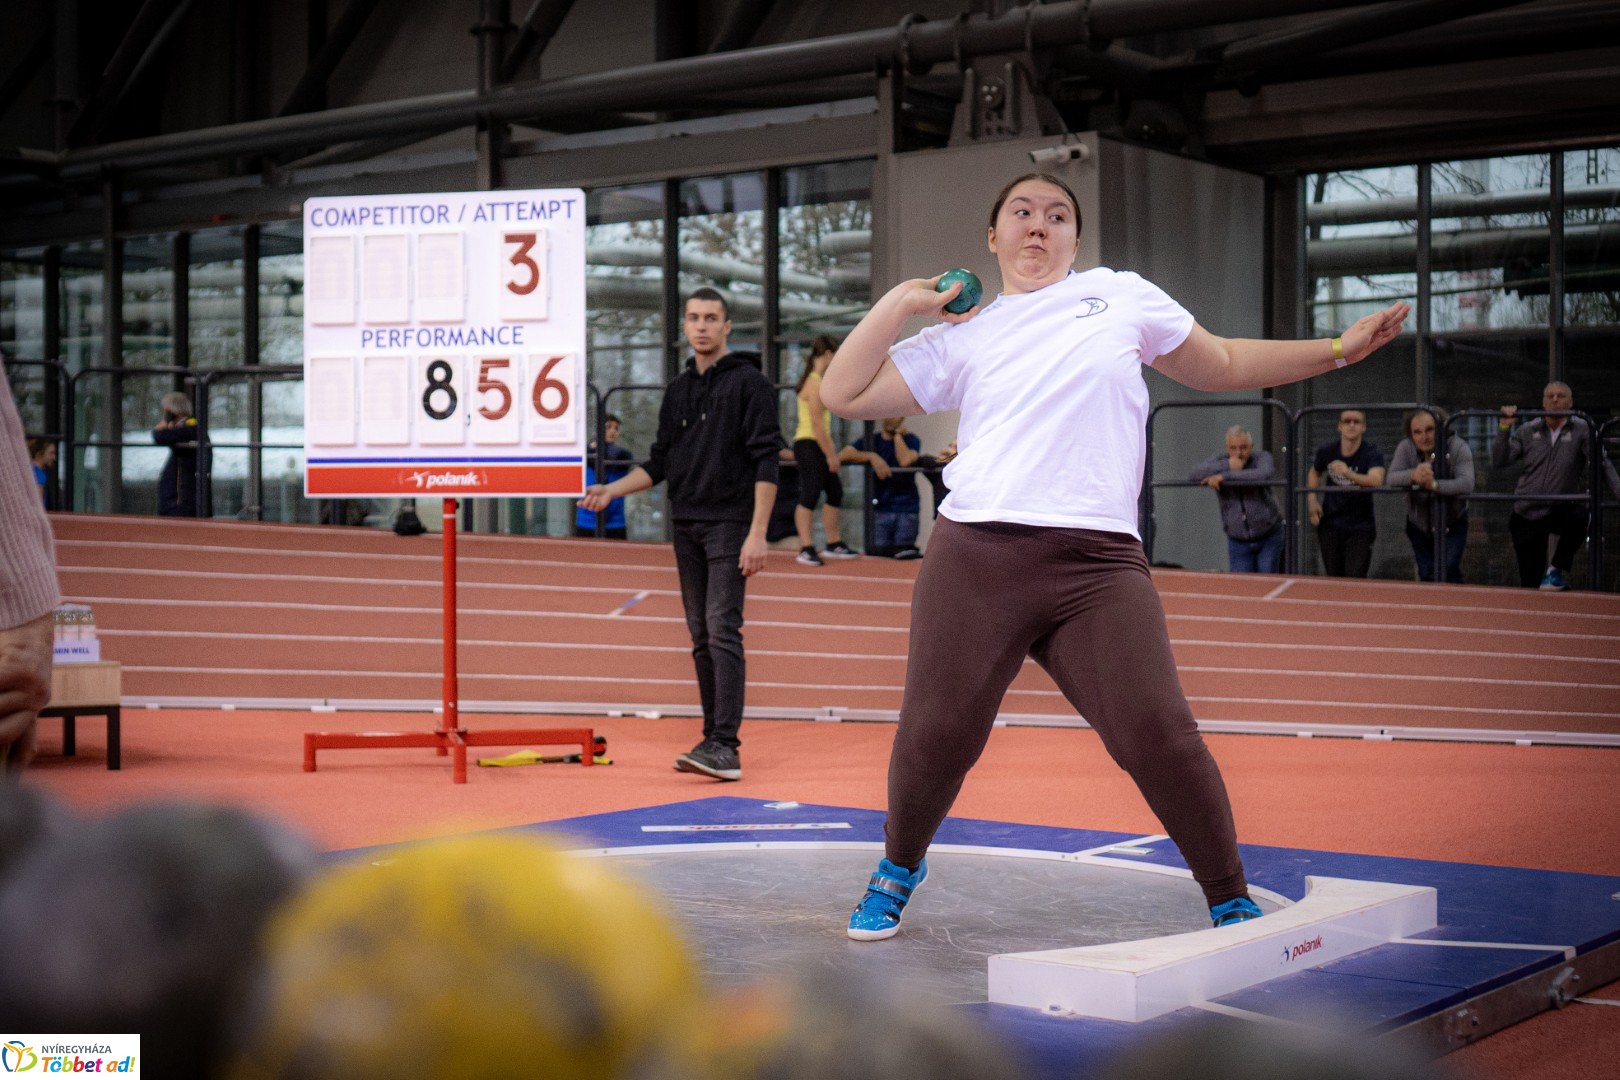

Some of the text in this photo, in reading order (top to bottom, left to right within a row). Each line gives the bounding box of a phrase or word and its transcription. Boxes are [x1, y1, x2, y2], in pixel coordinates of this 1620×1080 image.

[310, 199, 577, 227] COMPETITOR / ATTEMPT
[504, 232, 540, 296] 3
[361, 326, 524, 348] PERFORMANCE
[426, 471, 478, 489] polanik
[71, 646, 90, 654] WELL
[1292, 934, 1322, 961] polanik
